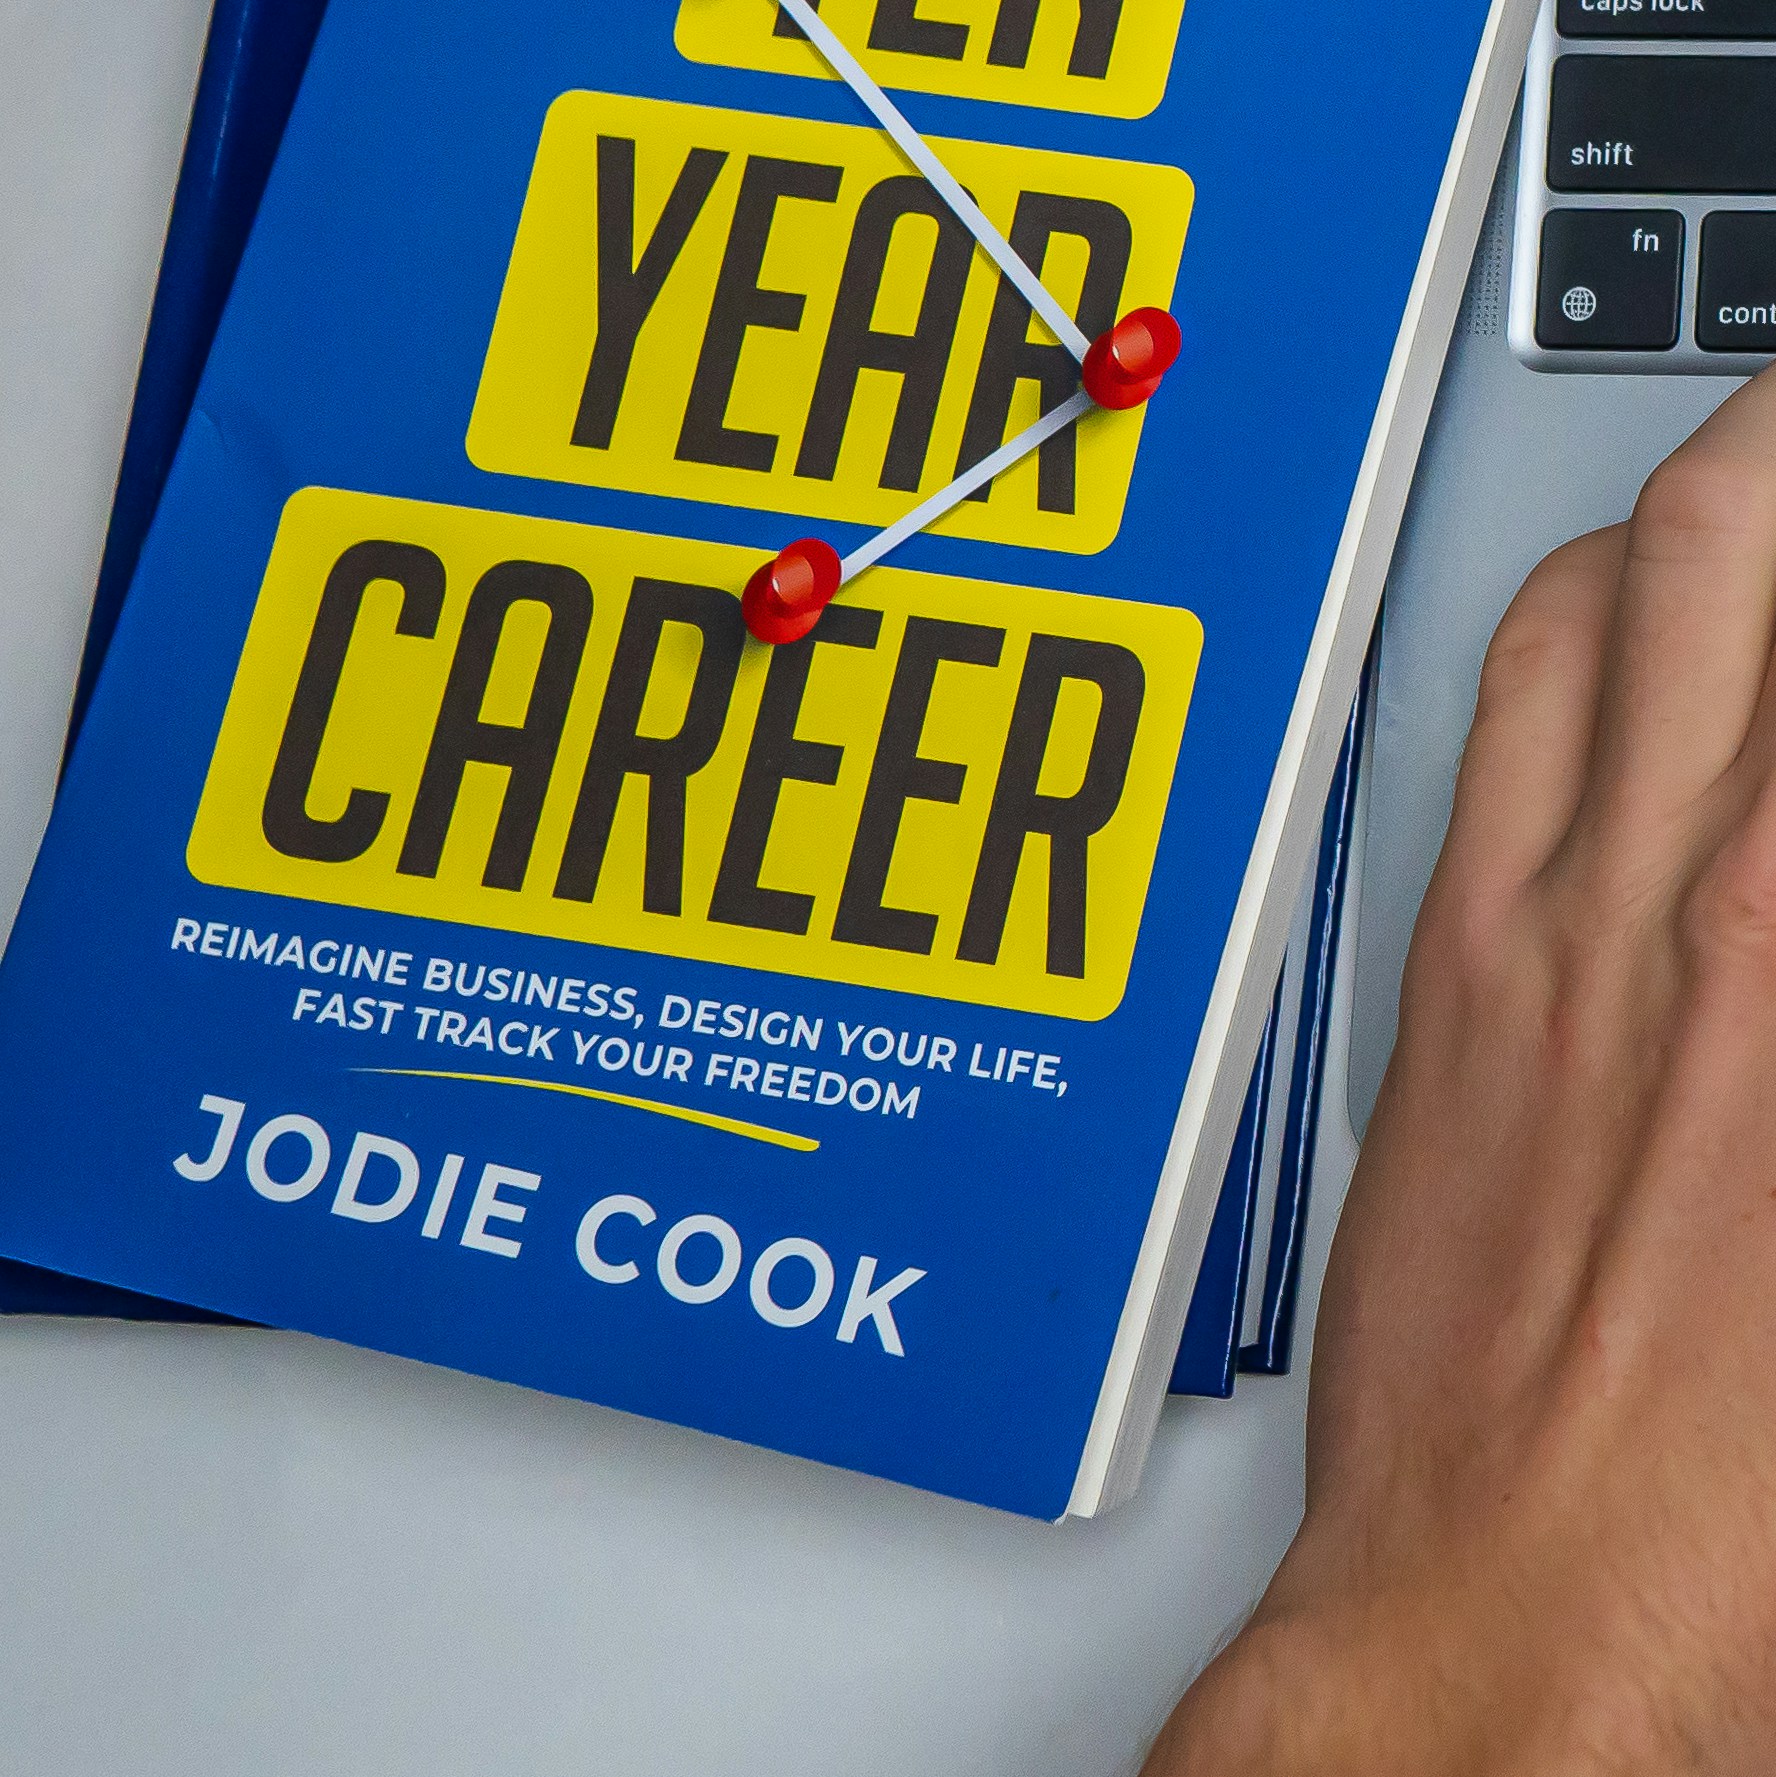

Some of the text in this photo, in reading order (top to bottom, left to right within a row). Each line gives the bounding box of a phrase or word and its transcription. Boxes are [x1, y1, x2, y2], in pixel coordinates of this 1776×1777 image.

[1571, 141, 1634, 166] shift
[1632, 228, 1659, 253] fn
[569, 134, 1133, 516] YEAR
[261, 539, 1147, 980] CAREER
[171, 917, 1068, 1098] REIMAGINE BUSINESS, DESIGN YOUR LIFE,
[292, 988, 921, 1119] FAST TRACK YOUR FREEDOM
[172, 1093, 928, 1357] JODIE COOK
